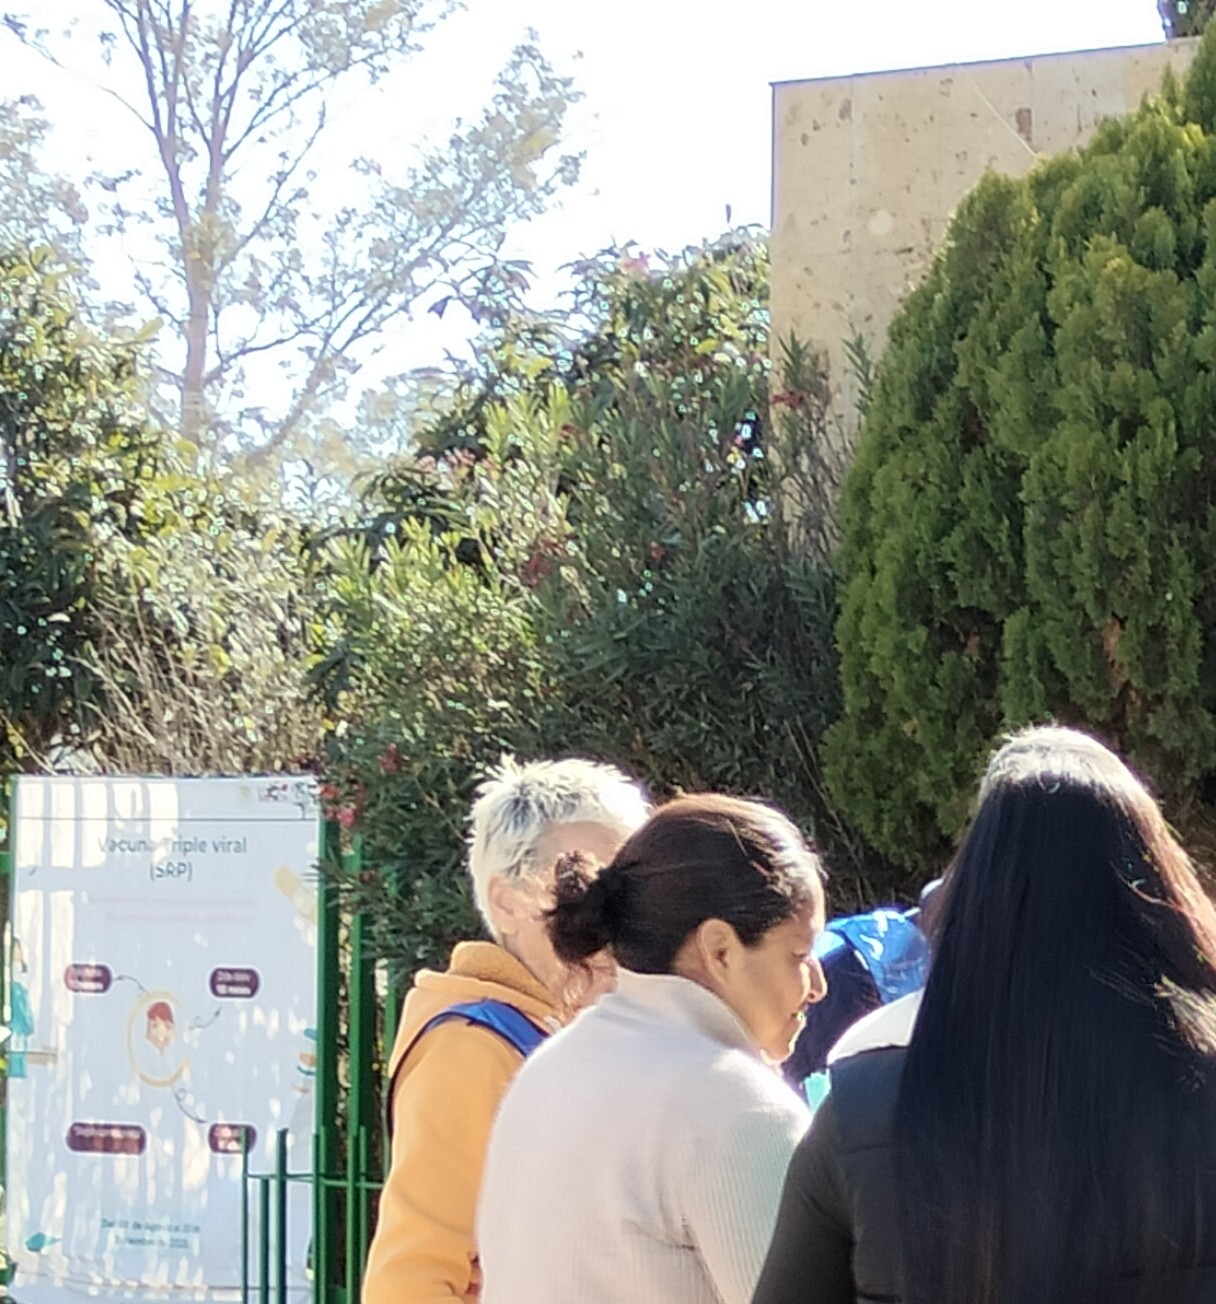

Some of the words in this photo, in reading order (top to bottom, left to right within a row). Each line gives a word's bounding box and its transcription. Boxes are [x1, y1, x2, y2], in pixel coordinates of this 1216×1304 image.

[162, 835, 207, 857] Triple
[211, 834, 247, 854] viral
[149, 860, 193, 883] (SRP)
